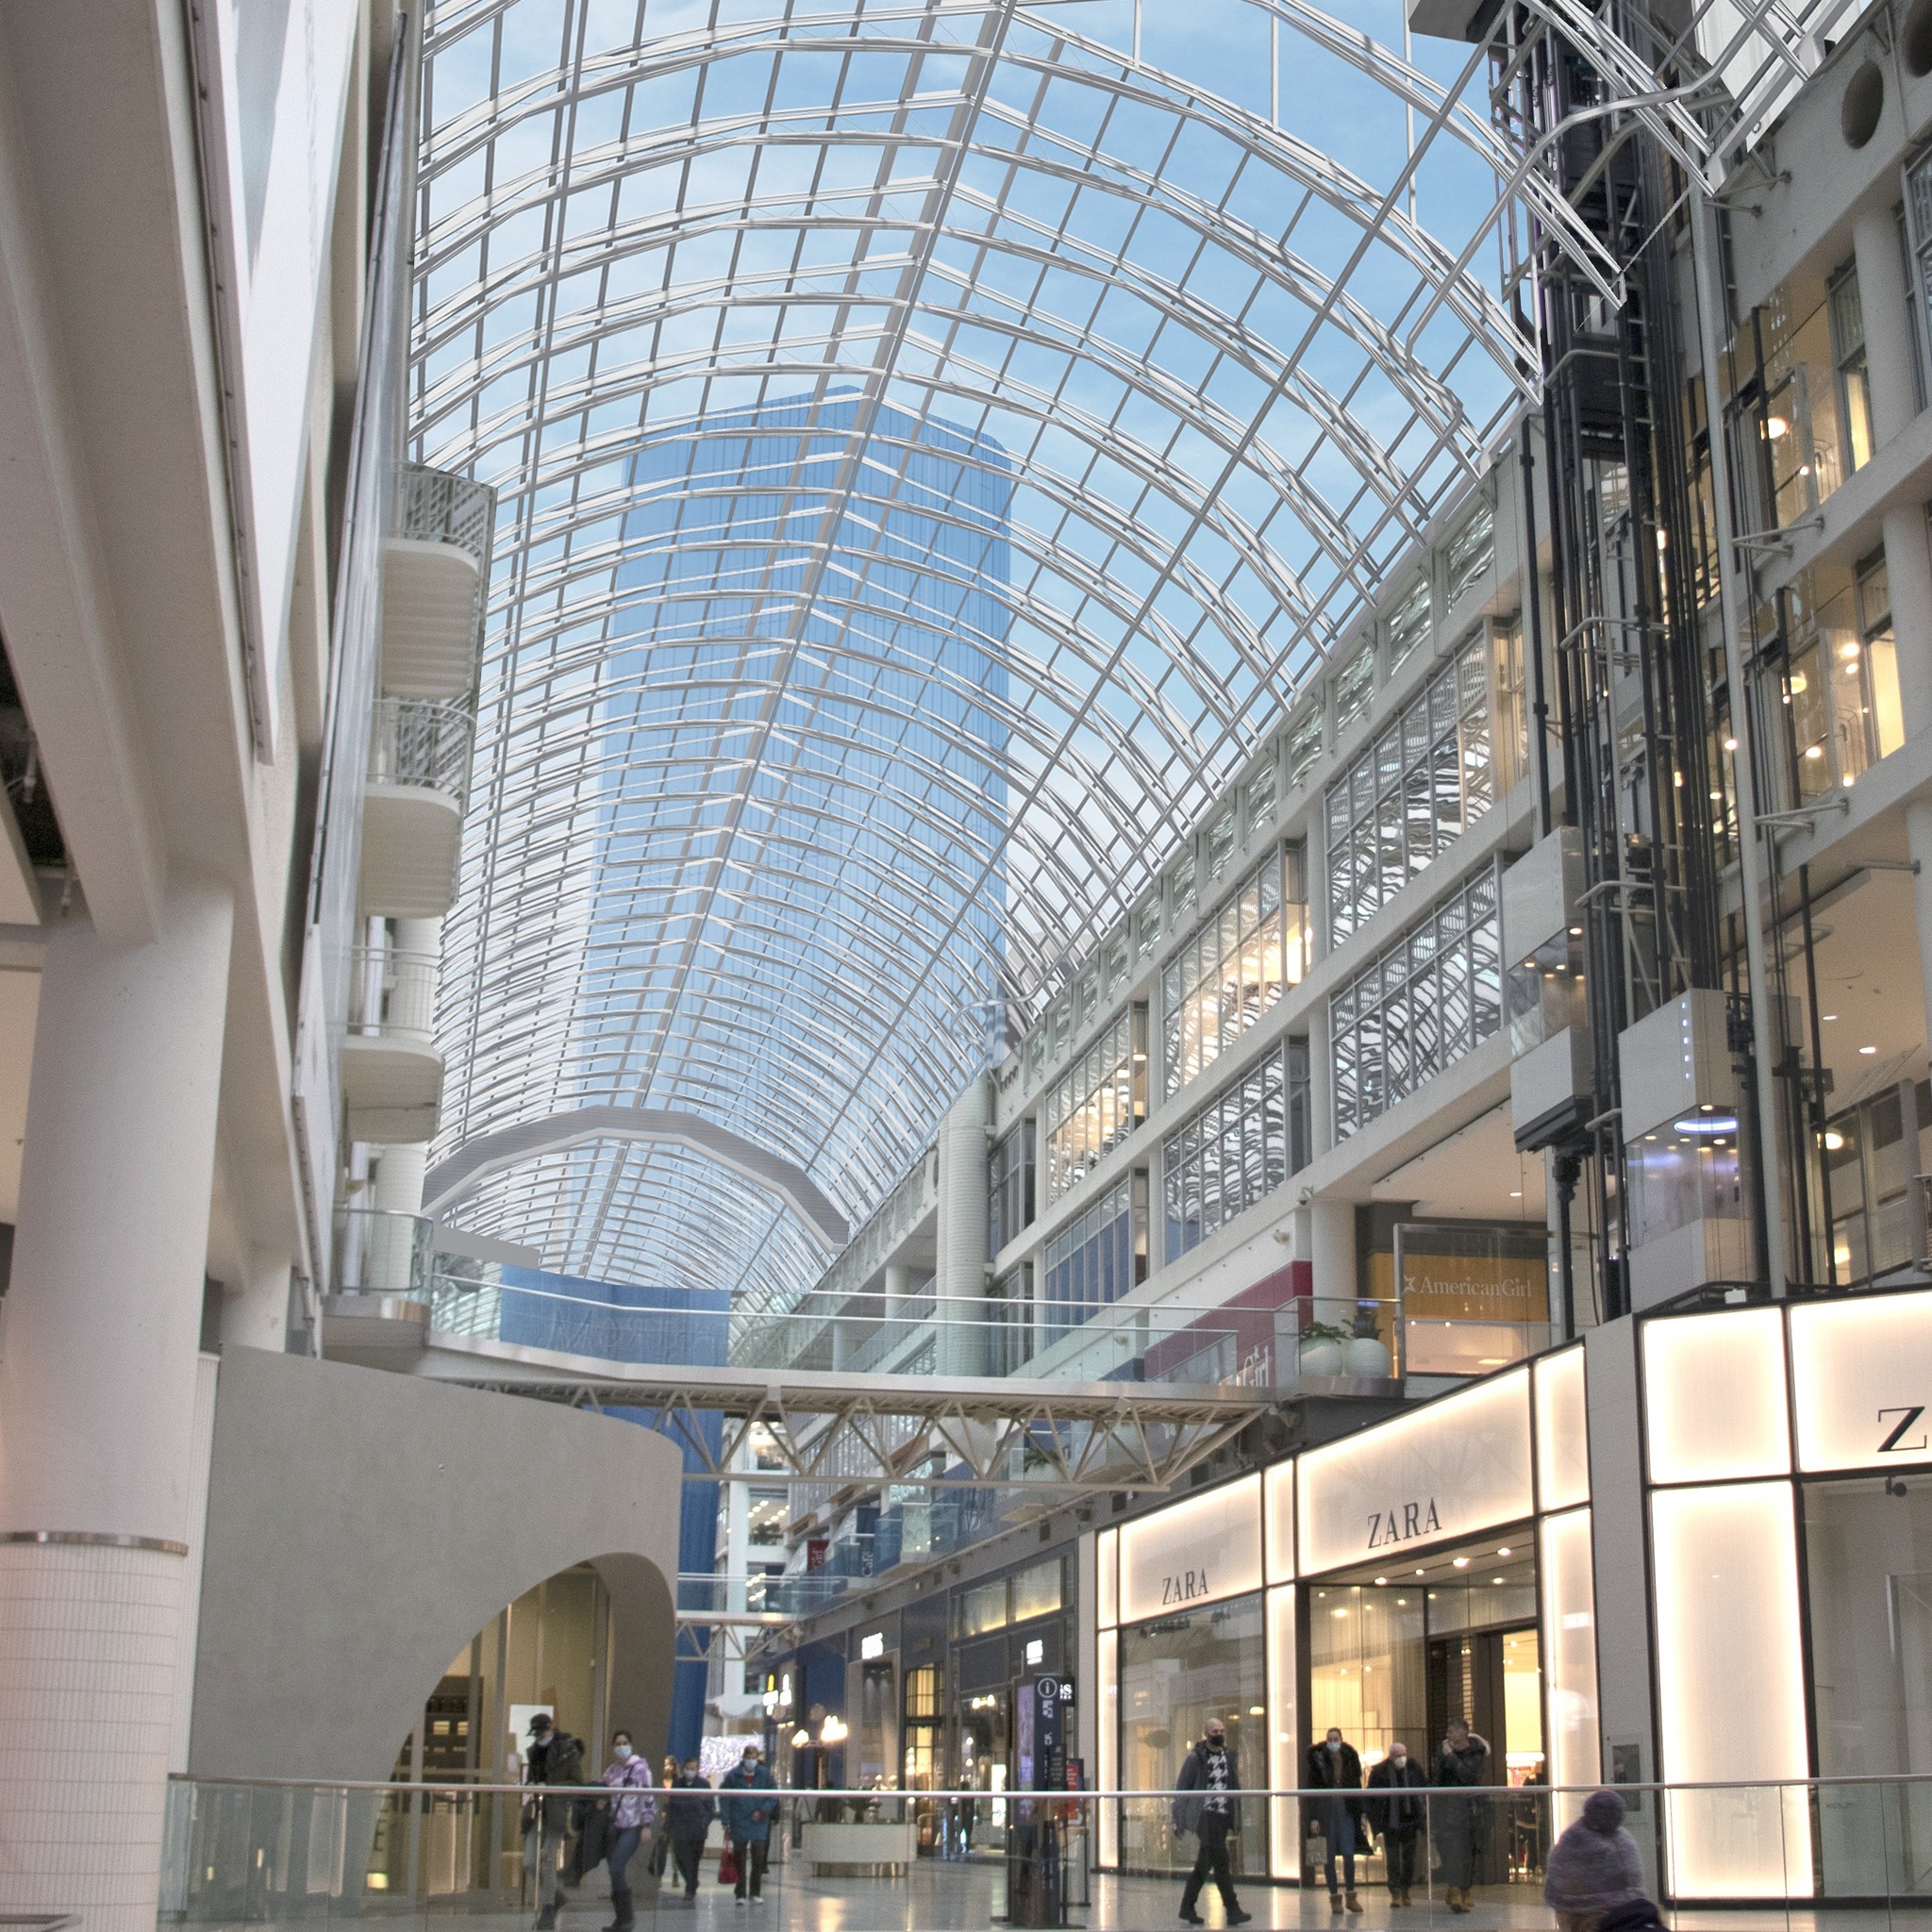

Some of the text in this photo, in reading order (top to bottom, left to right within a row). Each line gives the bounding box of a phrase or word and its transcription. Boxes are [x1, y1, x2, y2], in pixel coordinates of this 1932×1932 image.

[1419, 1275, 1532, 1297] American Girl
[1877, 1406, 1927, 1453] Z
[1367, 1496, 1442, 1549] ZARA
[1161, 1567, 1209, 1606] ZARA
